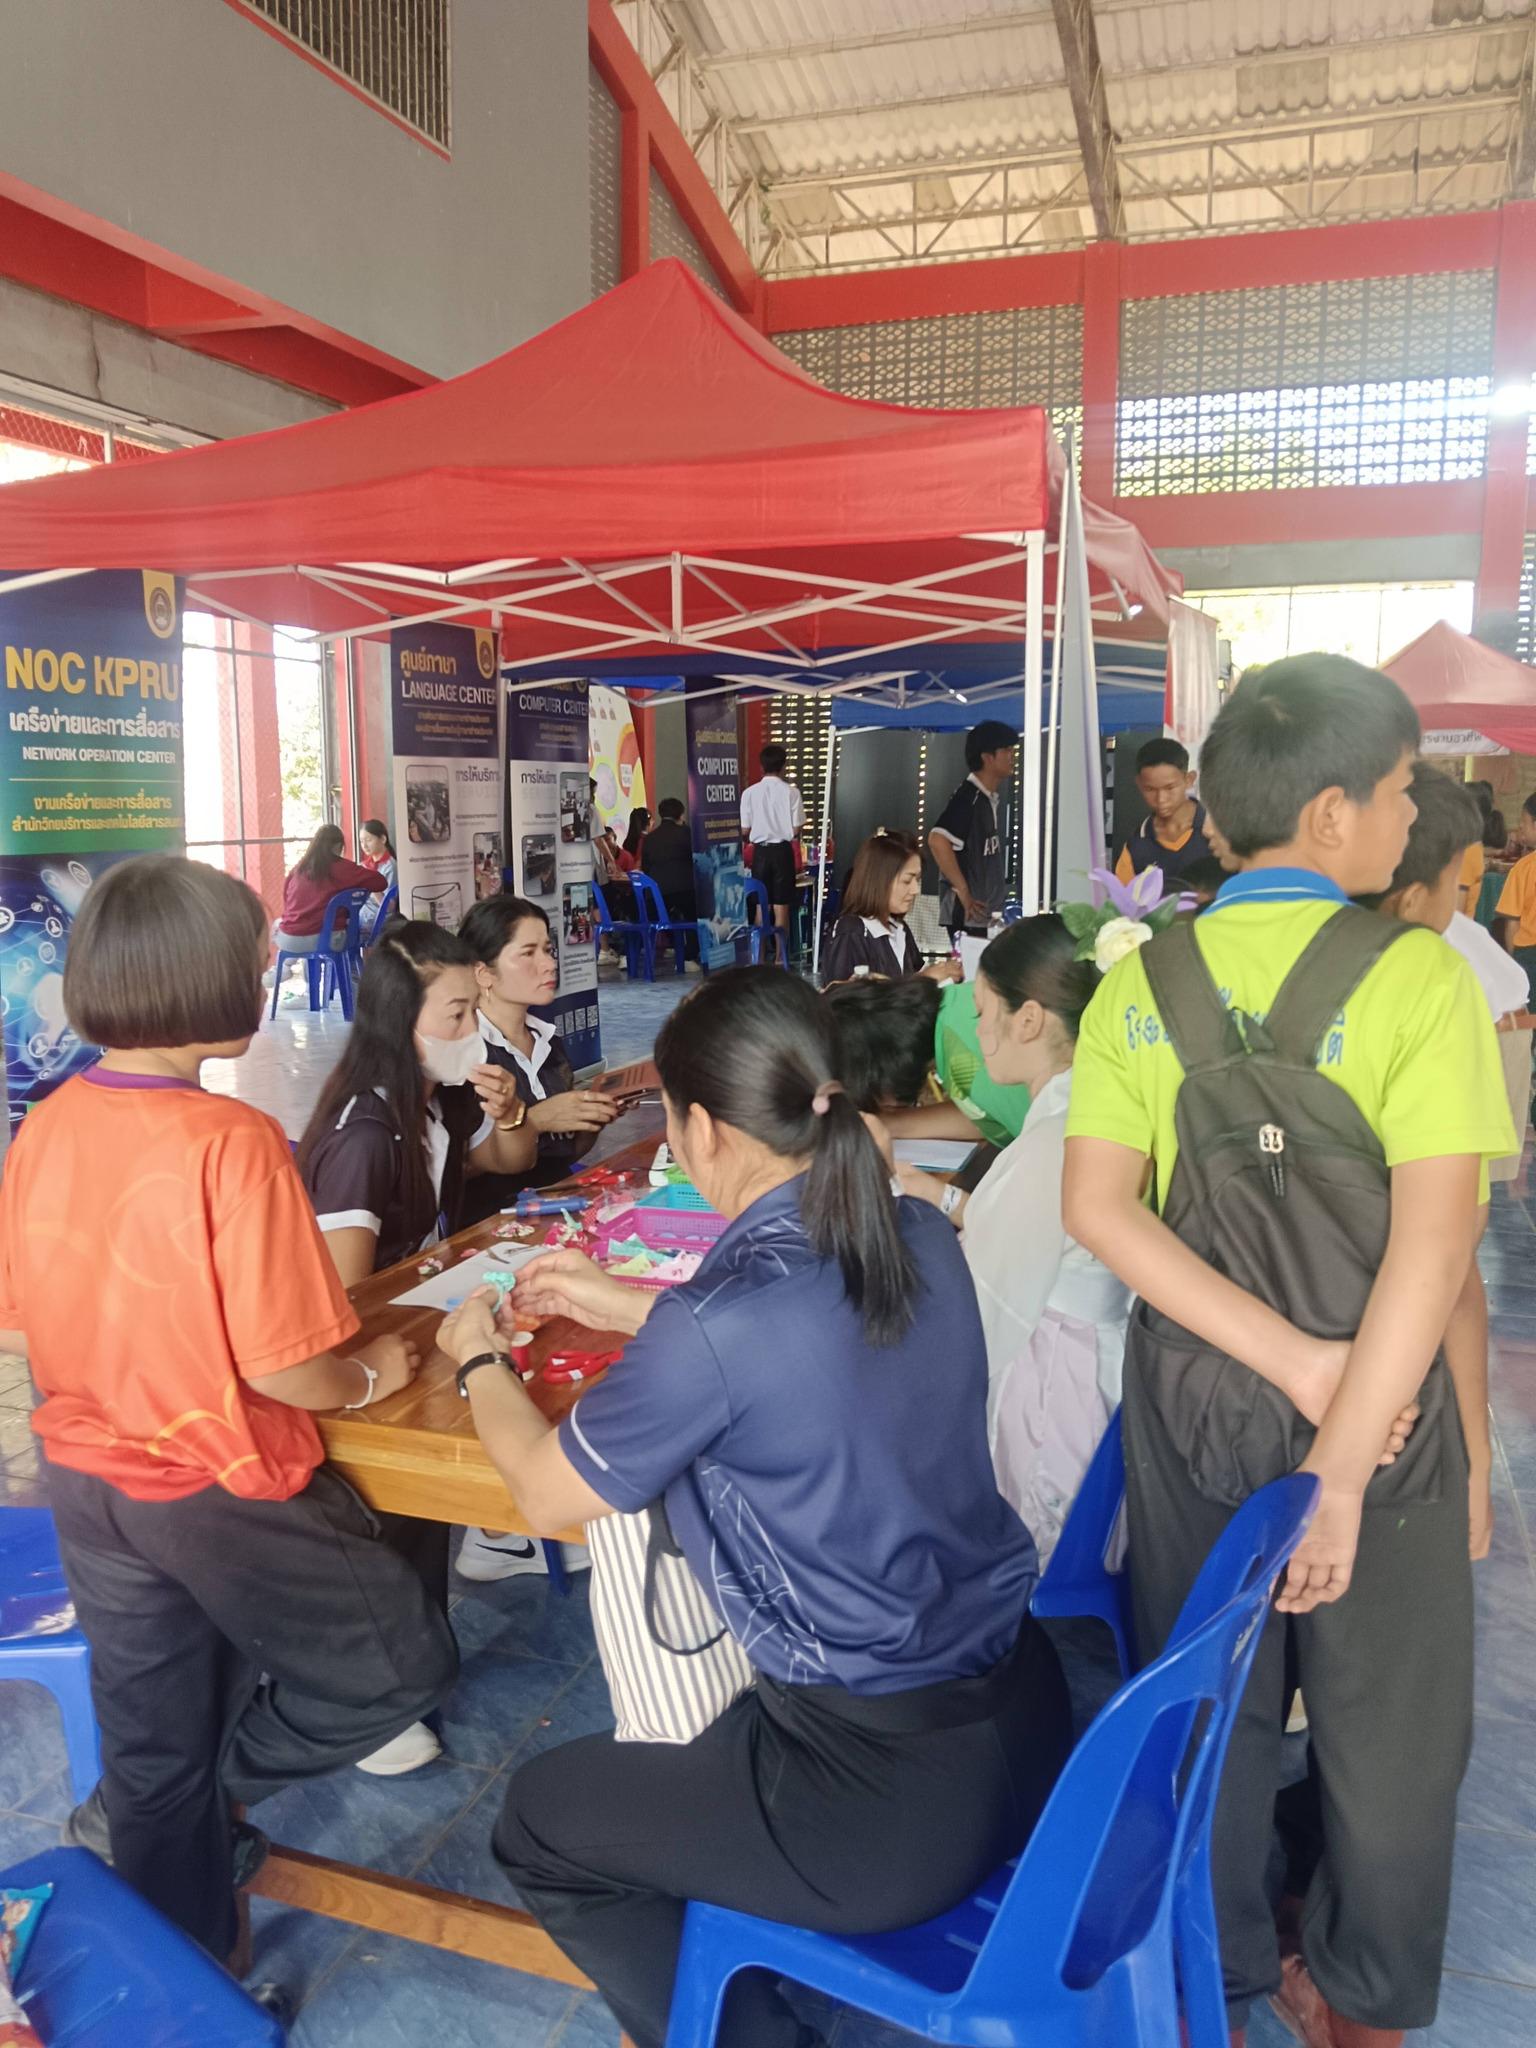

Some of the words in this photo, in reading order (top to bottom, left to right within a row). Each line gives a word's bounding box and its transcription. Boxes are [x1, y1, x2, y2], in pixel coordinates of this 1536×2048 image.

[400, 646, 457, 678] ศูนย์ภาษา
[5, 646, 87, 694] NOC
[94, 656, 179, 702] KPRU
[401, 680, 458, 702] LANGUAGE
[519, 694, 561, 713] COMPUTER
[9, 706, 181, 739] เครือข่ายและการสื่อสาร
[22, 746, 77, 761] NETWORK
[79, 748, 135, 763] OPERATION
[136, 750, 177, 764] CENTER
[697, 757, 739, 776] COMPUTER
[706, 784, 736, 803] CENTER
